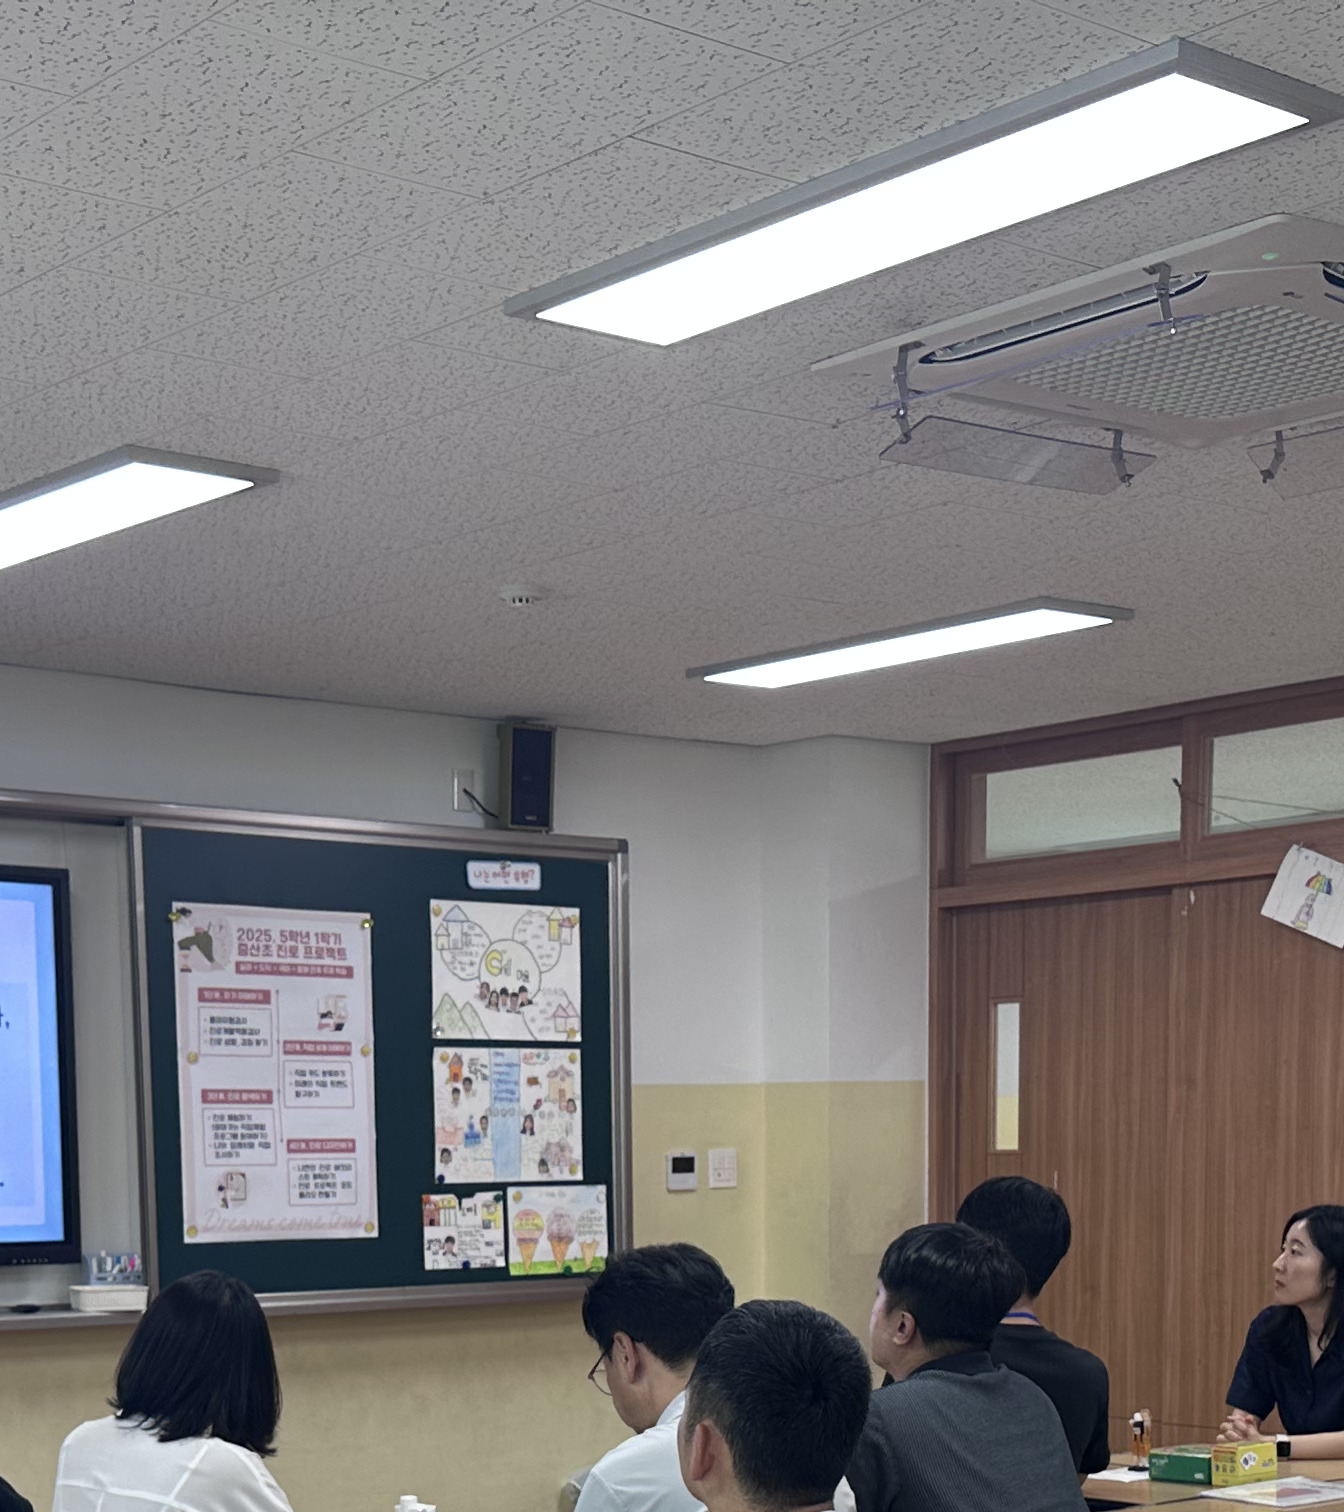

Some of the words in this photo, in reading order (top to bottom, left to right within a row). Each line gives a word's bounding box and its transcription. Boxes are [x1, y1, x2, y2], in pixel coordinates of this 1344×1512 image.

[236, 927, 276, 943] 2025.
[279, 930, 311, 945] 5학년
[314, 932, 342, 946] 1학기
[275, 945, 301, 959] 진로
[302, 945, 348, 961] 프로젝트
